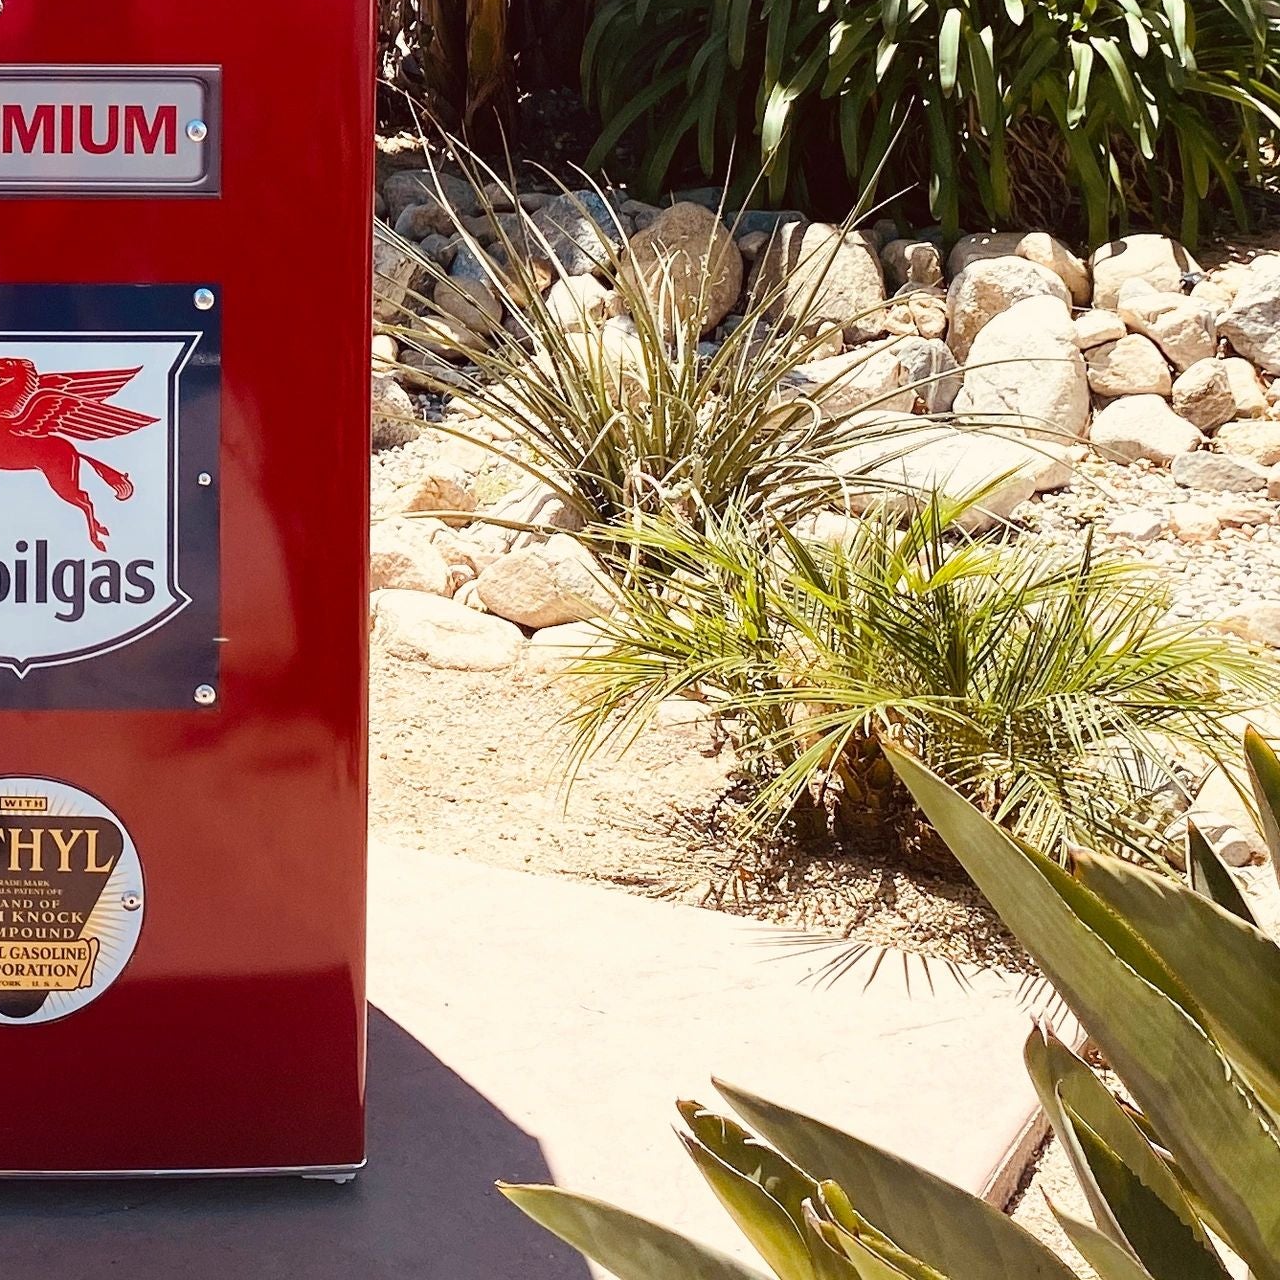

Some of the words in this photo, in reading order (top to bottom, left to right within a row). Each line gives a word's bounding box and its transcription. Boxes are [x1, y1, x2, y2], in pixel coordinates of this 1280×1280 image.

[4, 799, 44, 808] WITH
[13, 888, 45, 896] PATENT
[39, 899, 61, 909] OF
[12, 911, 84, 924] KNOCK
[9, 946, 87, 960] GASOLINE
